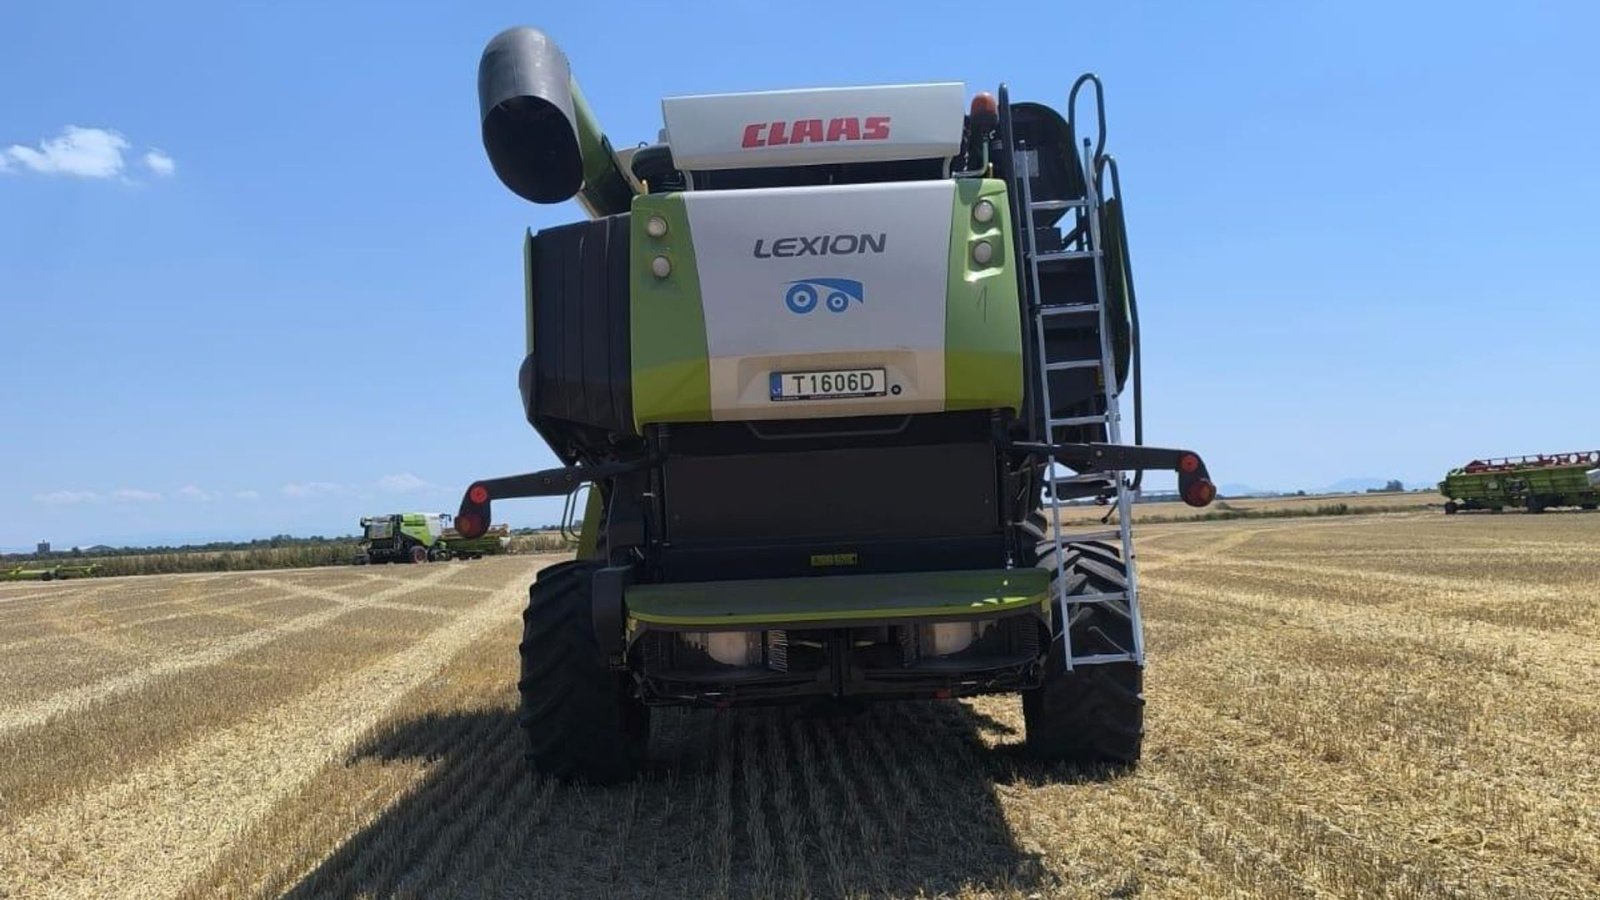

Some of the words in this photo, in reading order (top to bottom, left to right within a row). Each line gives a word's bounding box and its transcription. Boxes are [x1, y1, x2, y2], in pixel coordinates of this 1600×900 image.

[741, 116, 891, 149] CLAAS
[753, 233, 887, 259] LEXION
[791, 372, 875, 394] T1606D
